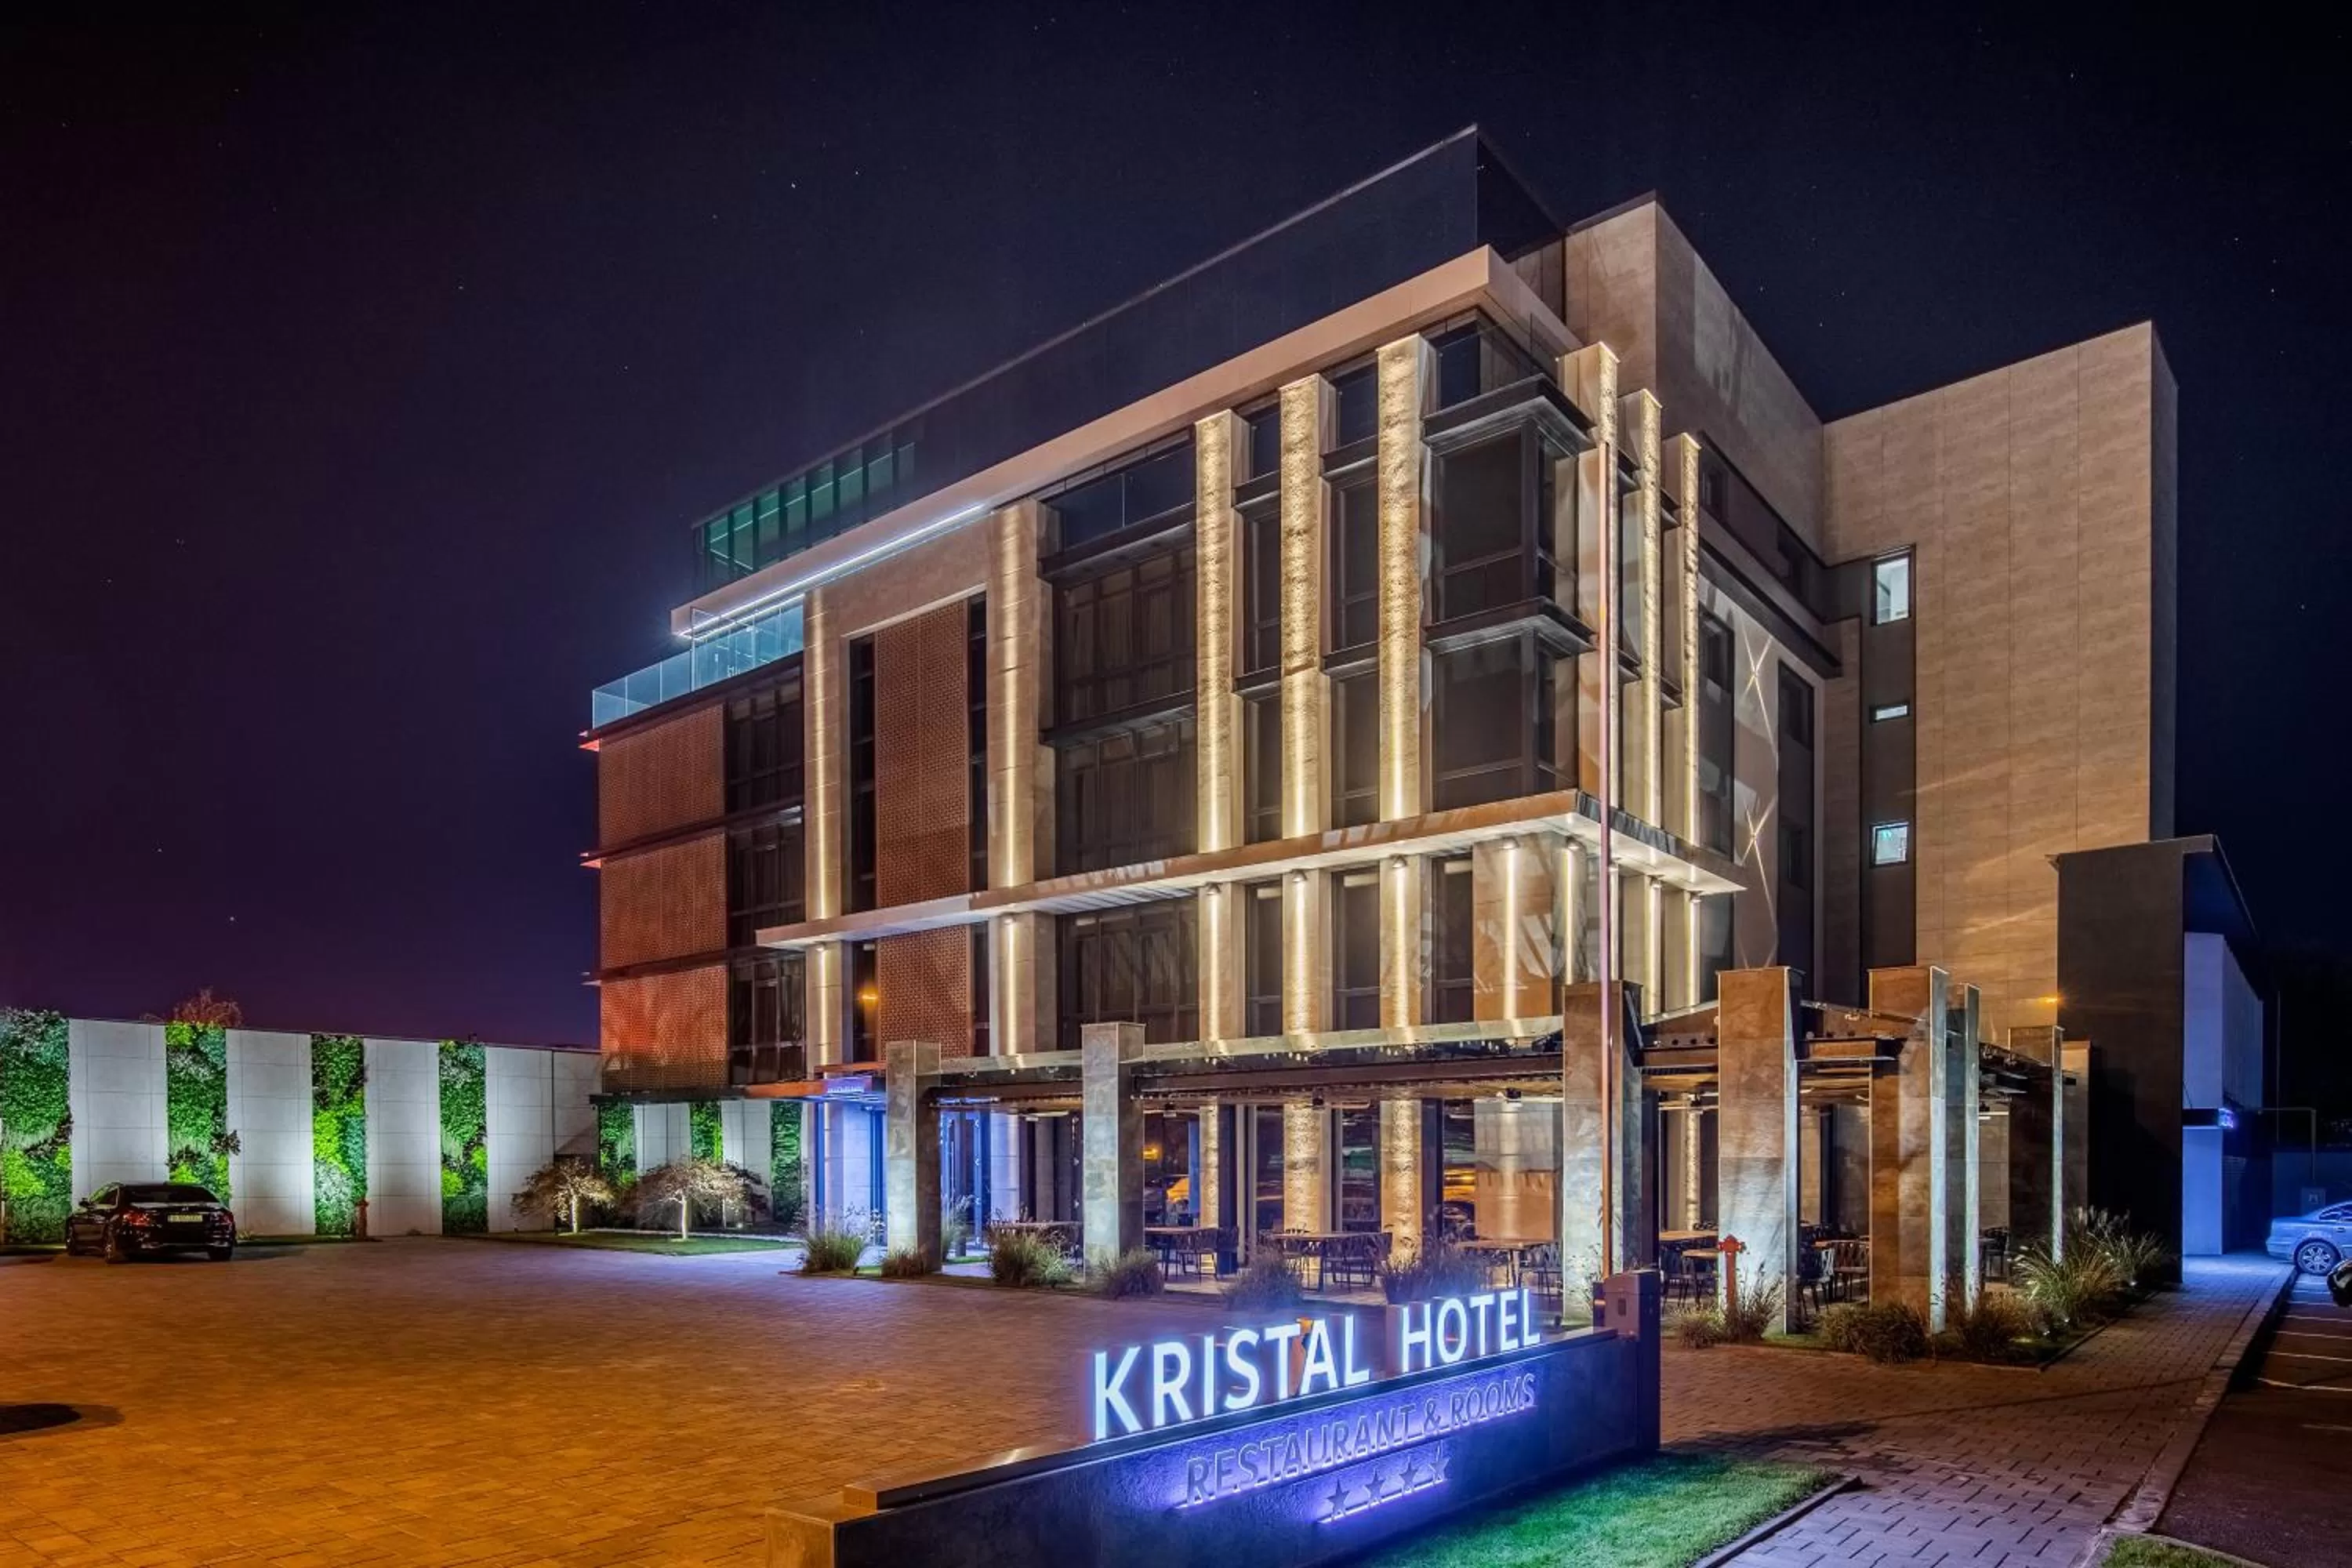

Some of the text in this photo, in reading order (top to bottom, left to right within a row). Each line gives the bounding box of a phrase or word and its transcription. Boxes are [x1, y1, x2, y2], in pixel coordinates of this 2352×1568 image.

[1094, 1288, 1541, 1441] KRISTAL HOTEL
[1186, 1373, 1536, 1504] RESTAURANT & ROOMS
